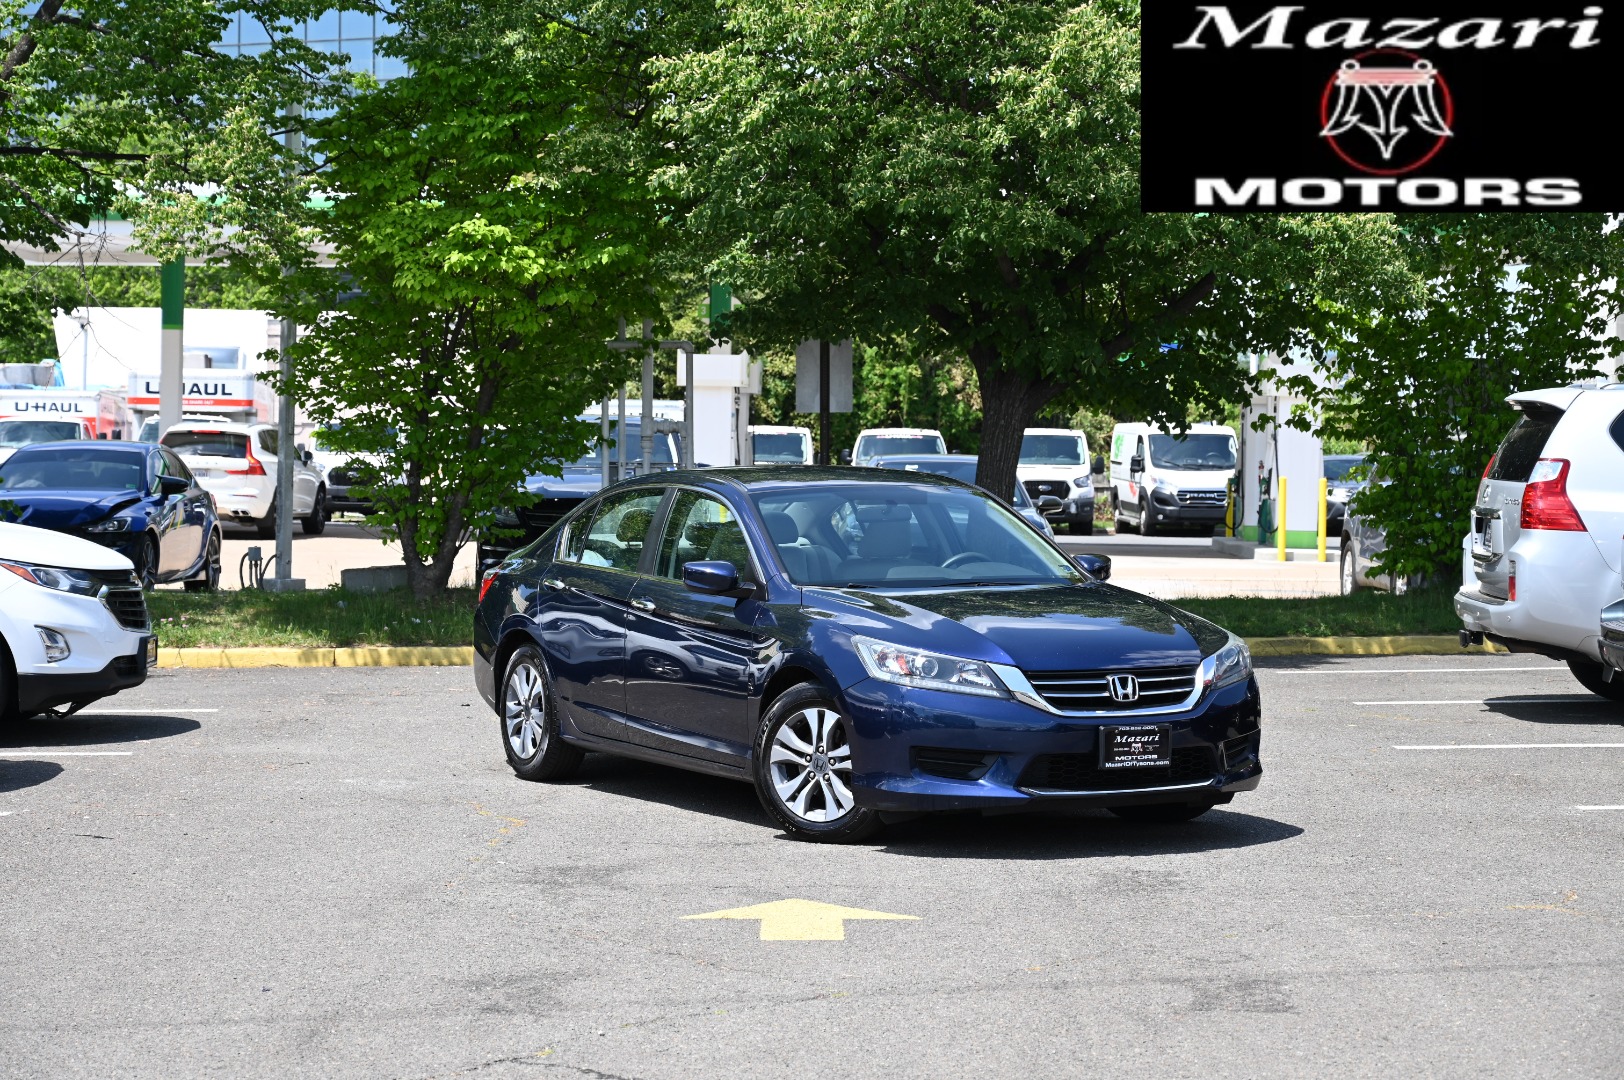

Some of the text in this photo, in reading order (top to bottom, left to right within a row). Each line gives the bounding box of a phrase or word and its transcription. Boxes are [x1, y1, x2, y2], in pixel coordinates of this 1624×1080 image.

[701, 306, 707, 315] 3
[145, 382, 232, 395] UAUL
[15, 402, 83, 413] U-HAUL
[1114, 734, 1160, 743] Mazari
